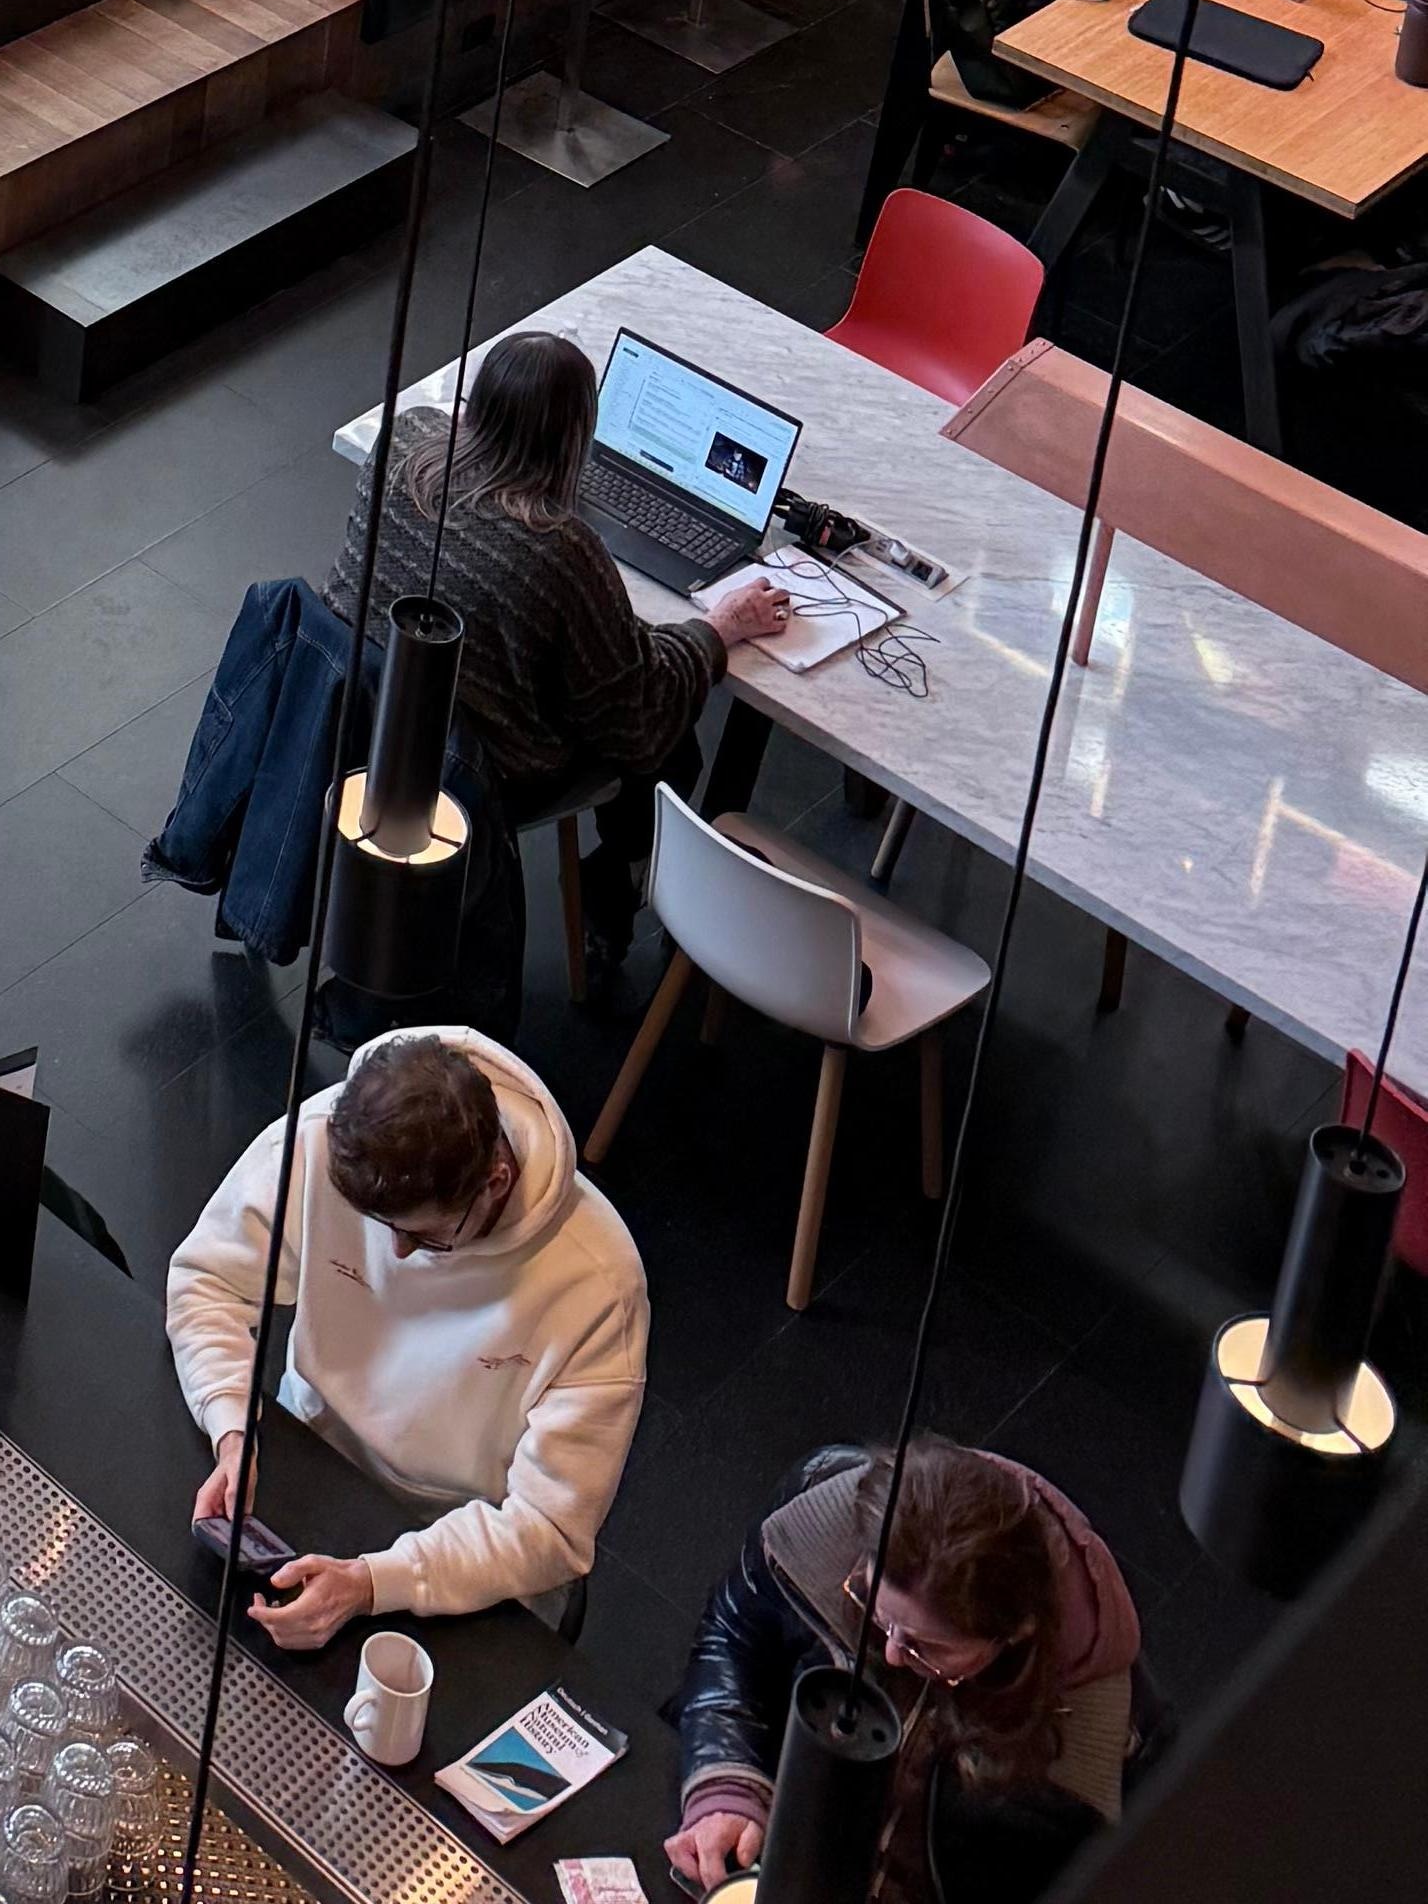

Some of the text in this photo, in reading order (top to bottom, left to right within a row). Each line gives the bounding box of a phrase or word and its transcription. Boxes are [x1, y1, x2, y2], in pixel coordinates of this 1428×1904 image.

[520, 1715, 557, 1754] History
[526, 1711, 565, 1751] Natural
[534, 1710, 576, 1750] Museum
[538, 1702, 590, 1749] American
